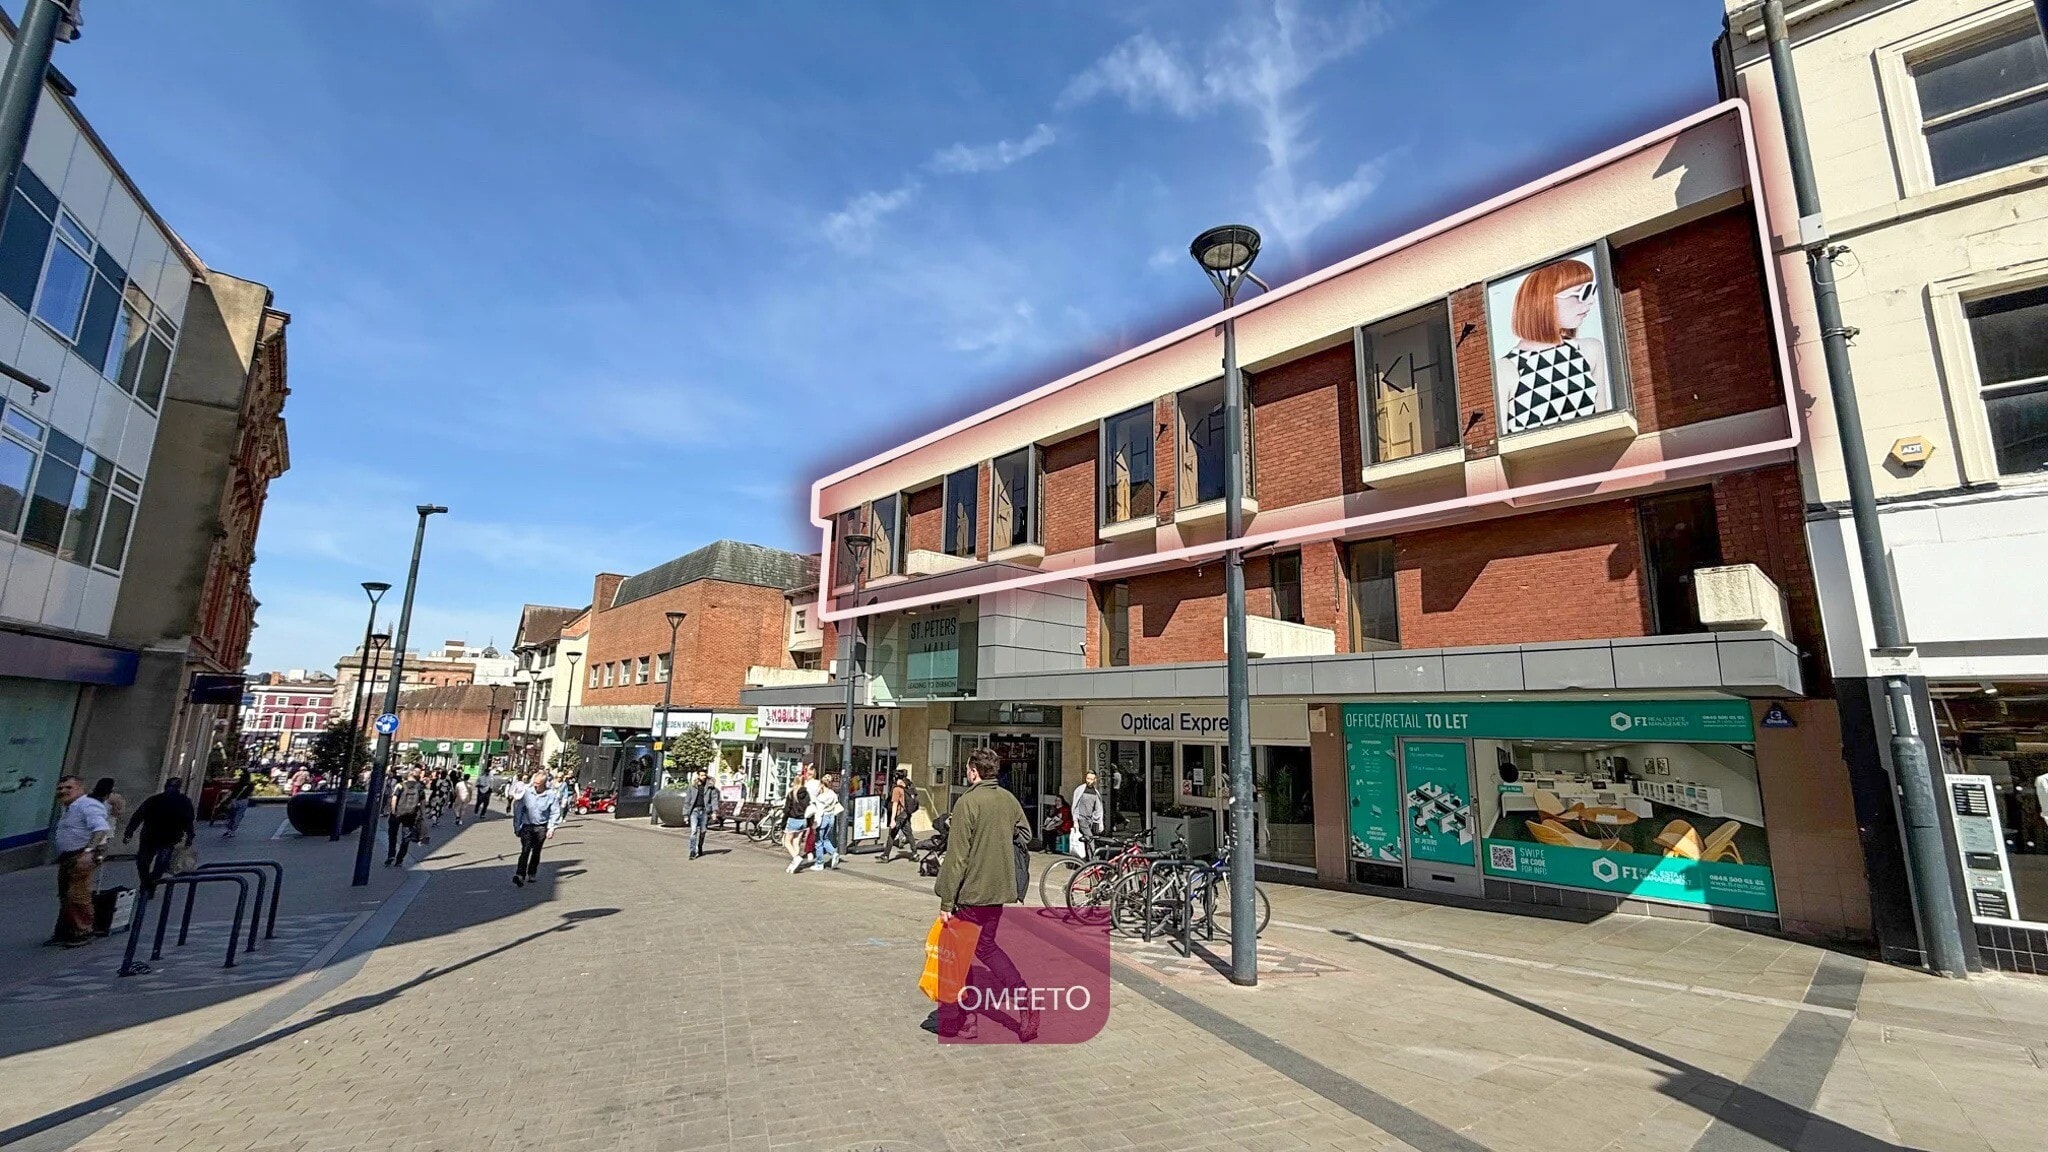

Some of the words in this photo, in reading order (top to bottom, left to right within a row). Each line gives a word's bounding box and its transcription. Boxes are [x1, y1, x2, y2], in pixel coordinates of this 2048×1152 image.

[1375, 344, 1445, 400] KH
[1111, 436, 1150, 477] KH
[1901, 444, 1922, 455] ADT
[771, 708, 799, 723] MOBILE
[1345, 713, 1422, 729] OFFICE/RETAIL
[1425, 713, 1442, 729] TO
[1445, 713, 1469, 730] LET
[864, 713, 887, 737] VIP
[1121, 712, 1174, 734] Optical
[1180, 712, 1229, 735] Expre
[1519, 847, 1545, 859] SWIPE
[1521, 865, 1533, 873] FOR
[1530, 858, 1546, 868] CODE
[1621, 866, 1639, 880] FI
